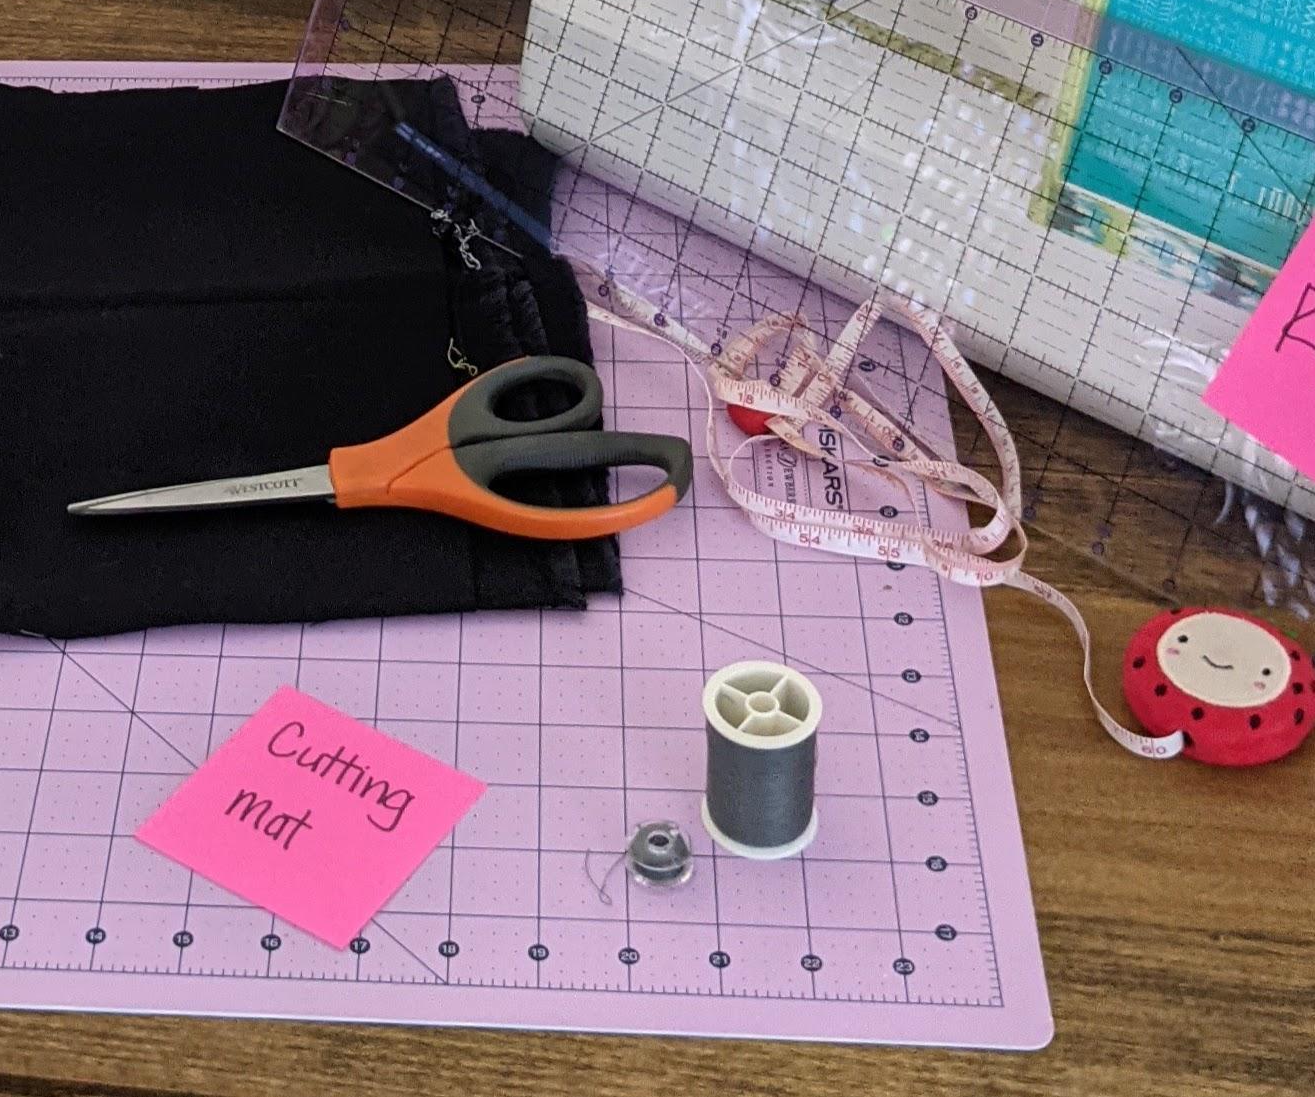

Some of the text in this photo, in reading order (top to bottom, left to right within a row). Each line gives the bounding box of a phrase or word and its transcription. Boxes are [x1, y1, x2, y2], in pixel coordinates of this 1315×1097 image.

[738, 393, 754, 405] 18
[817, 423, 842, 507] ISKARS
[224, 477, 301, 496] WESTCOTT
[774, 508, 795, 520] 34
[799, 534, 820, 546] 54
[877, 546, 900, 558] 55
[267, 721, 416, 832] Cutting
[223, 788, 314, 851] mat
